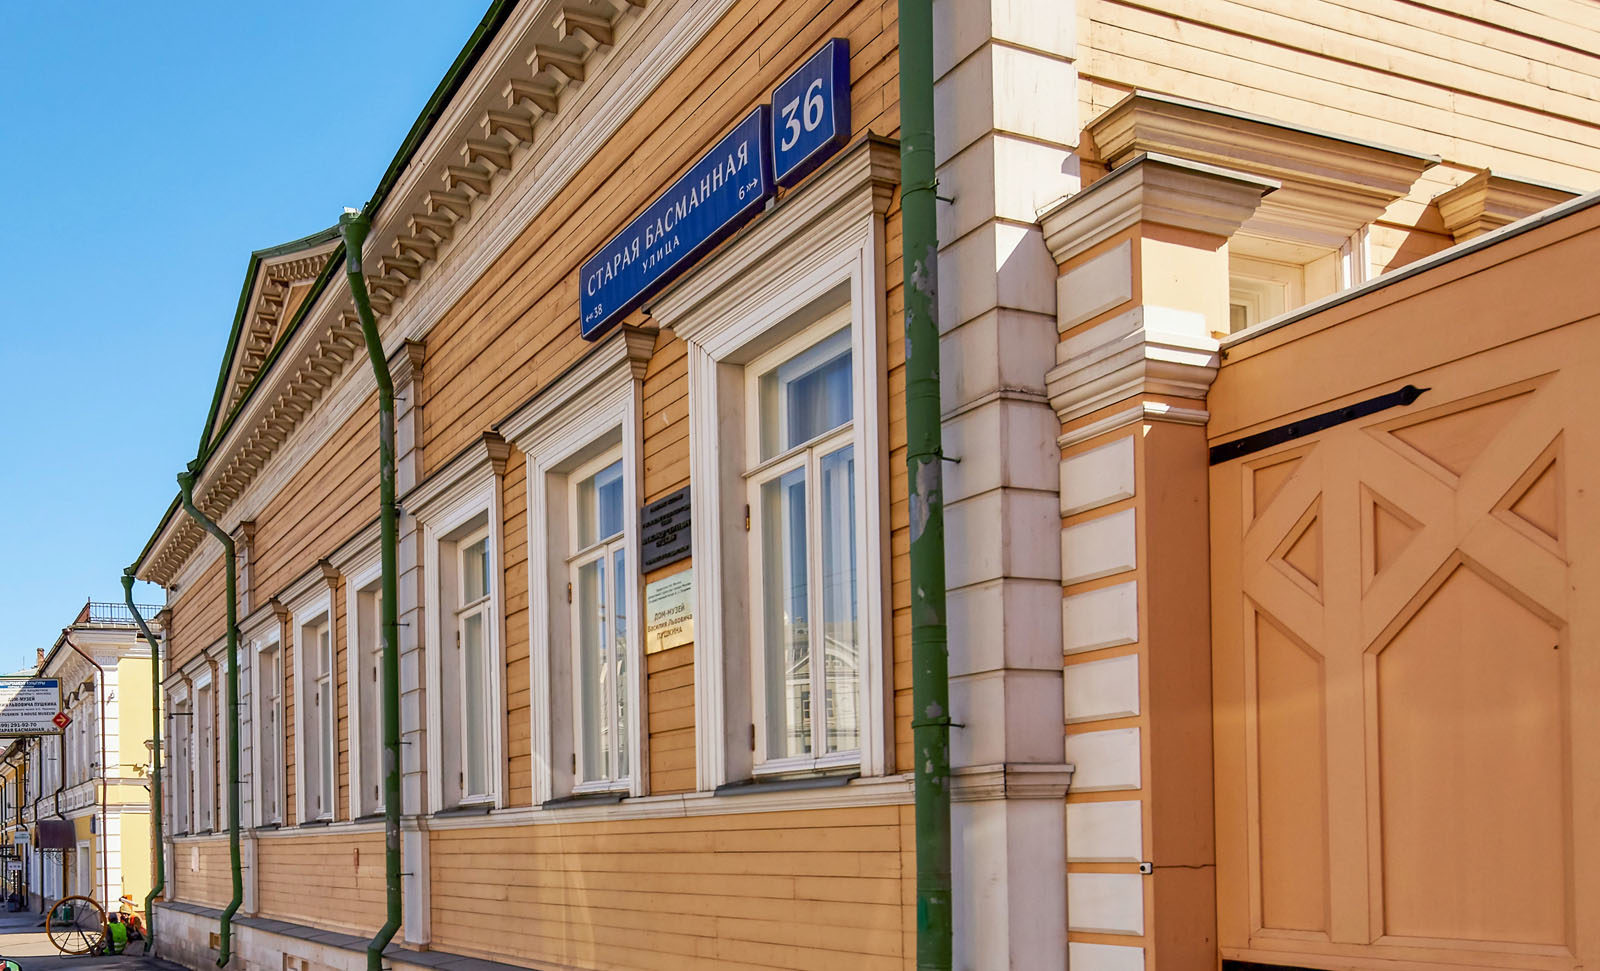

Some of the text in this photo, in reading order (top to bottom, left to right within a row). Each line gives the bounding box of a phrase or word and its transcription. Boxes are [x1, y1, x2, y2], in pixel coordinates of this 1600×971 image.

[781, 78, 824, 152] 36
[738, 186, 745, 200] 6
[587, 140, 748, 297] СТАРАЯ БАСМАННАЯ
[642, 235, 680, 274] УЛИЦА
[593, 303, 603, 319] 38
